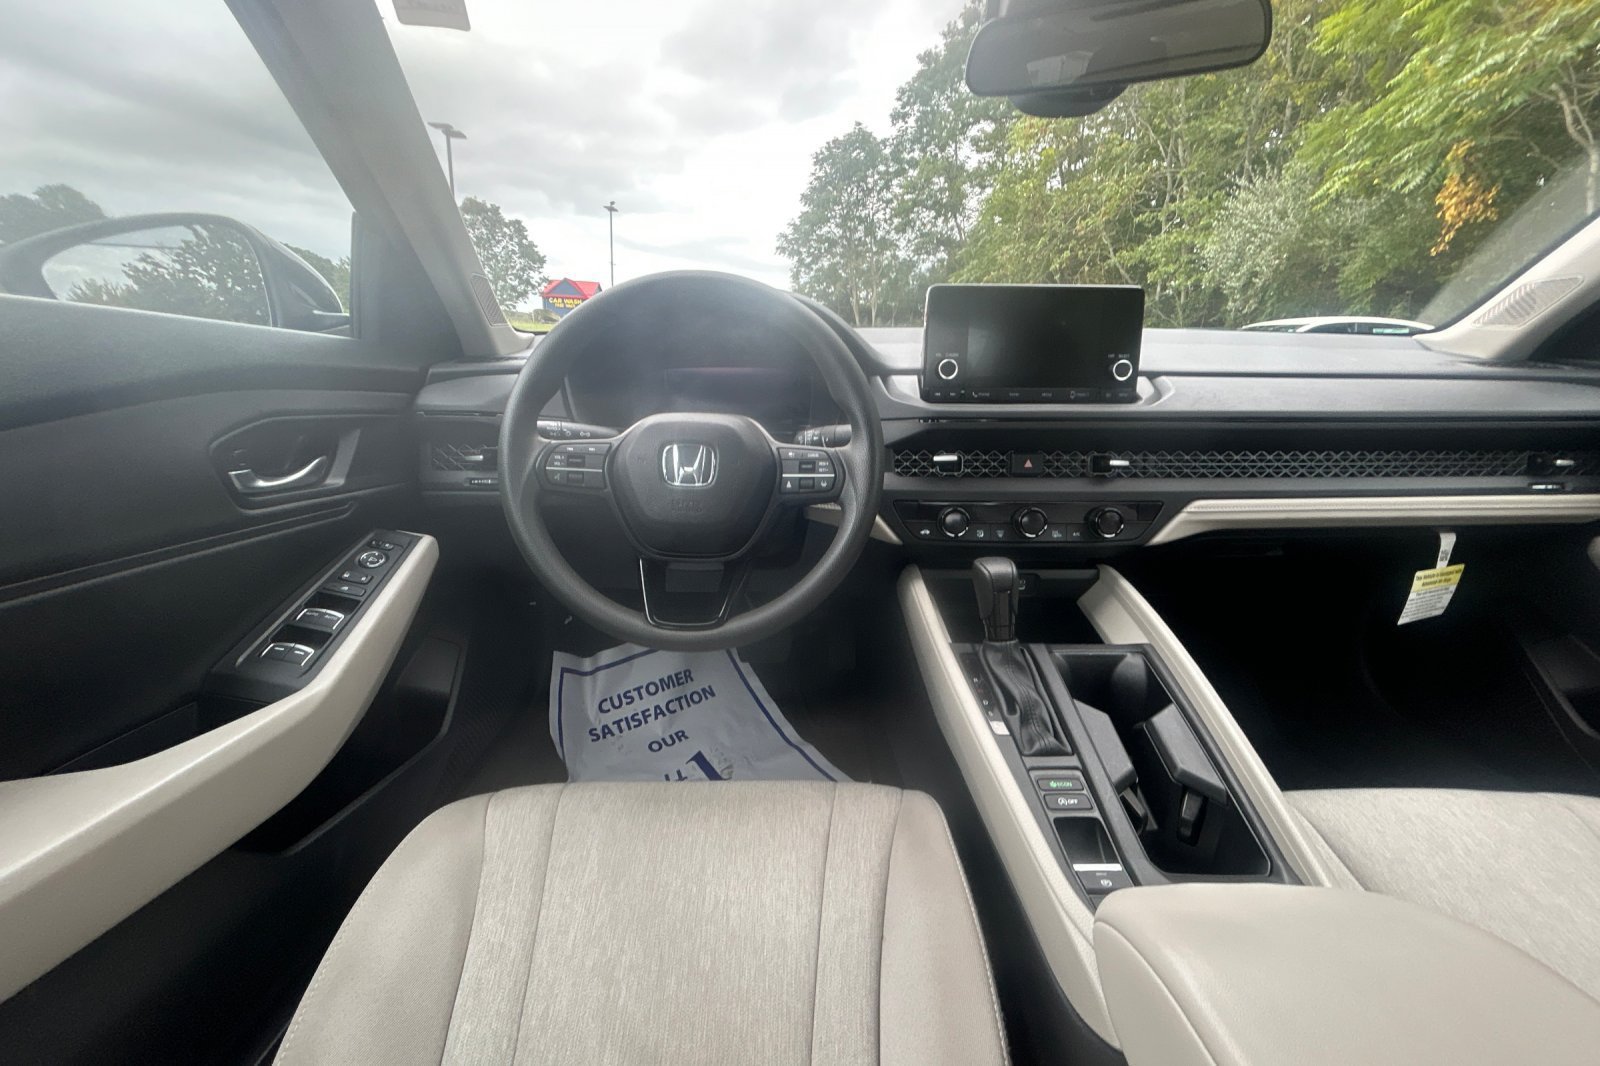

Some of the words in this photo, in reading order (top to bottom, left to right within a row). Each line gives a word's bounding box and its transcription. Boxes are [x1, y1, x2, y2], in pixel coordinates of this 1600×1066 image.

[588, 685, 716, 742] SATISFACTION
[598, 668, 694, 714] CUSTOMER
[647, 729, 689, 753] OUR
